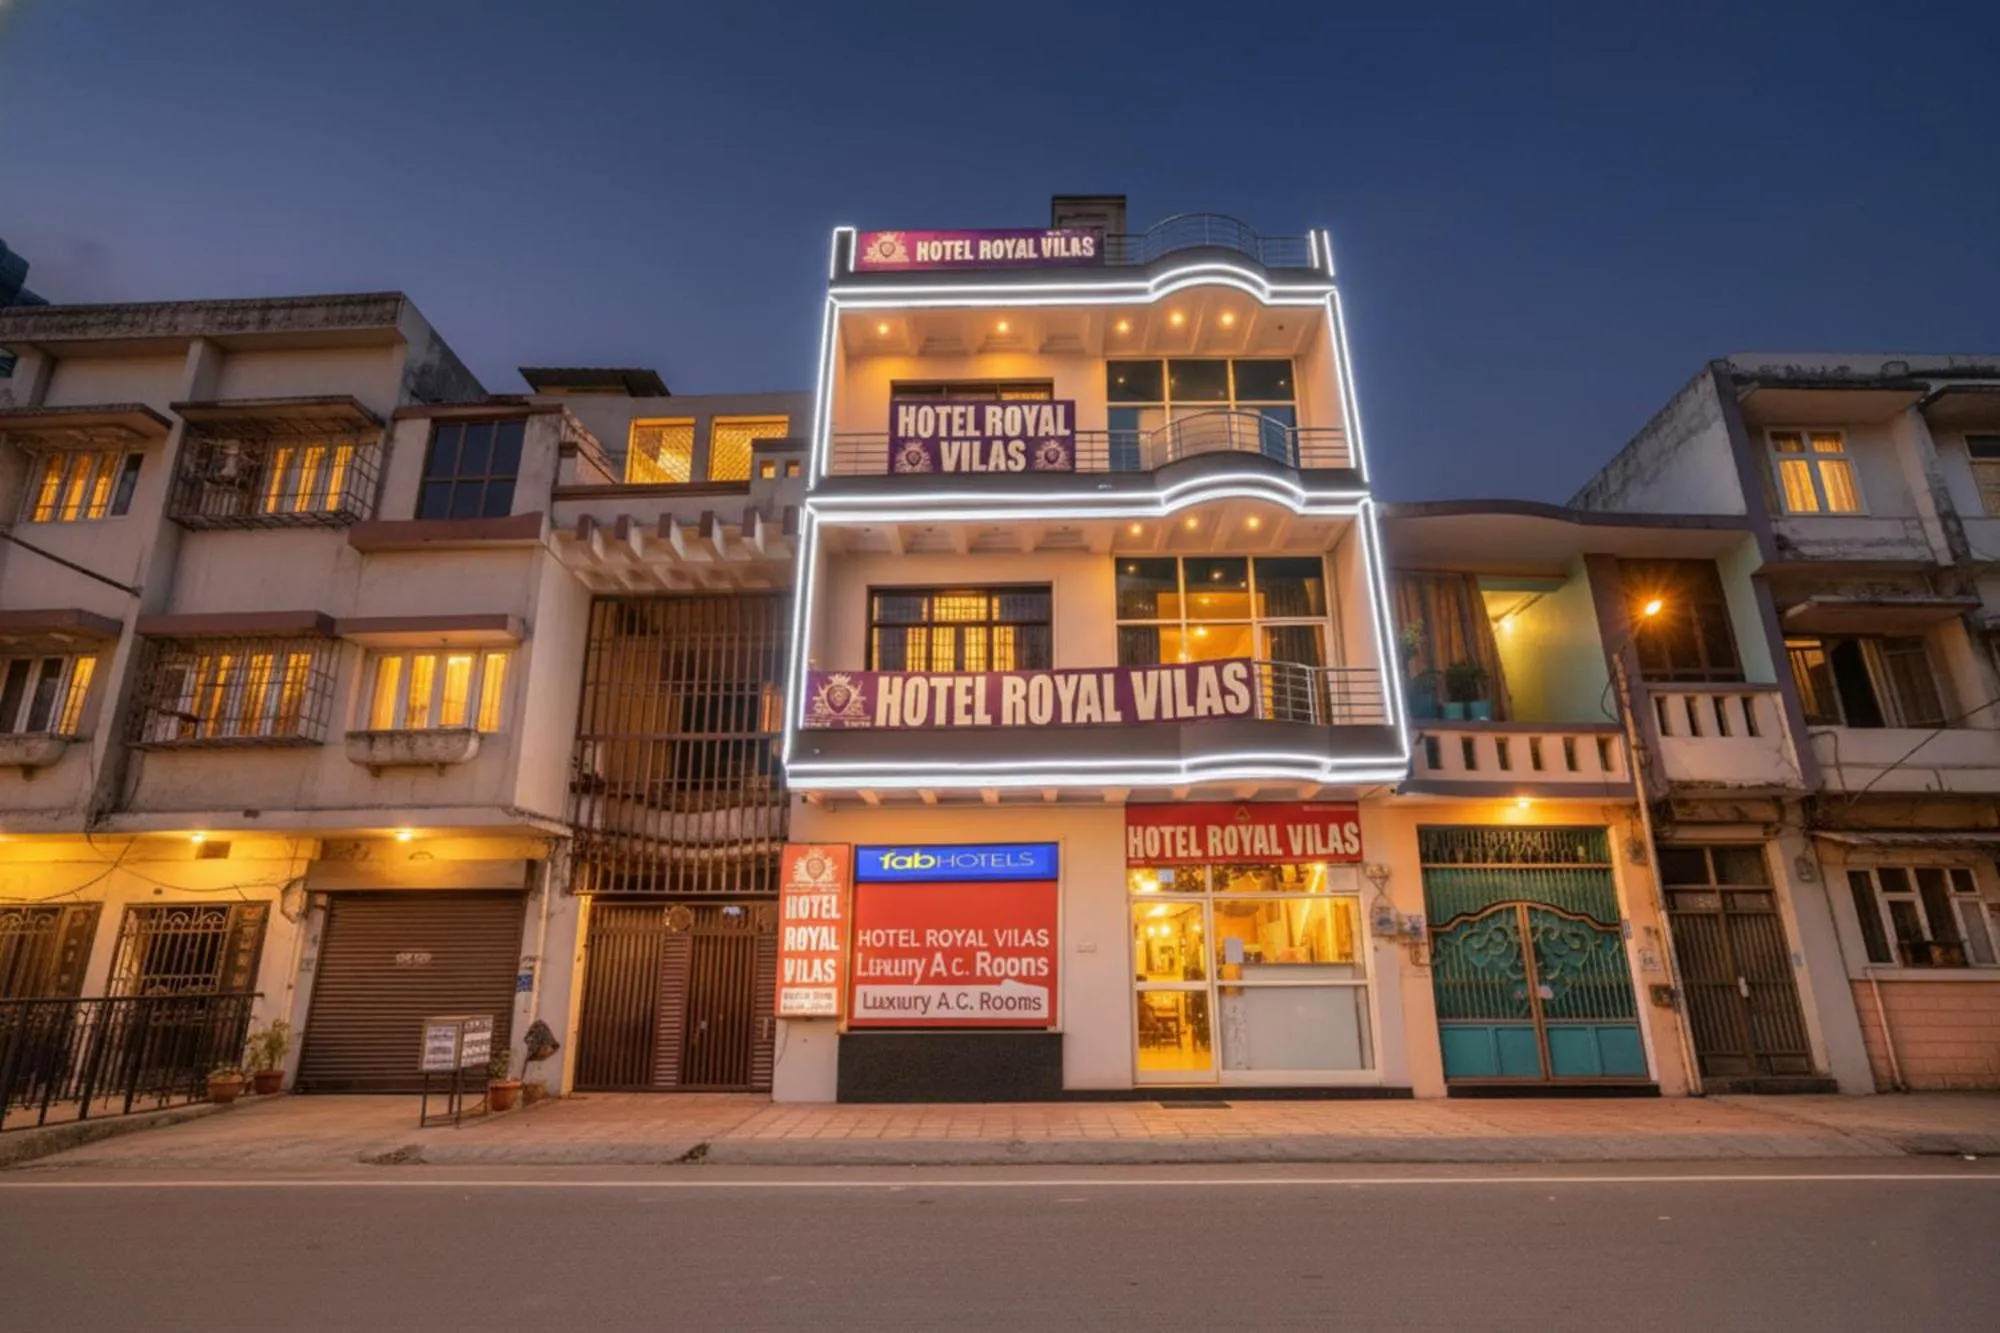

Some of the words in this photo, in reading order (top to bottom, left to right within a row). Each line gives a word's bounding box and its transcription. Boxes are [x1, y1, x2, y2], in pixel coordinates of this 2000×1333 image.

[916, 239, 971, 262] HOTEL
[979, 237, 1038, 260] ROYAL
[1041, 236, 1095, 258] VILAS
[897, 404, 981, 439] HOTEL
[984, 404, 1071, 438] ROYAL
[939, 439, 1026, 473] VILAS
[874, 675, 991, 727] HOTEL
[1000, 673, 1122, 726] ROYAL
[1130, 662, 1252, 721] VILAS
[1127, 825, 1203, 859] HOTEL
[1206, 823, 1282, 857] ROYAL
[1286, 821, 1360, 856] VILAS
[783, 926, 840, 952] ROYAL
[857, 928, 920, 948] HOTEL
[926, 928, 988, 948] ROYAL
[783, 957, 836, 984] VILAS
[980, 991, 1042, 1011] Rooms
